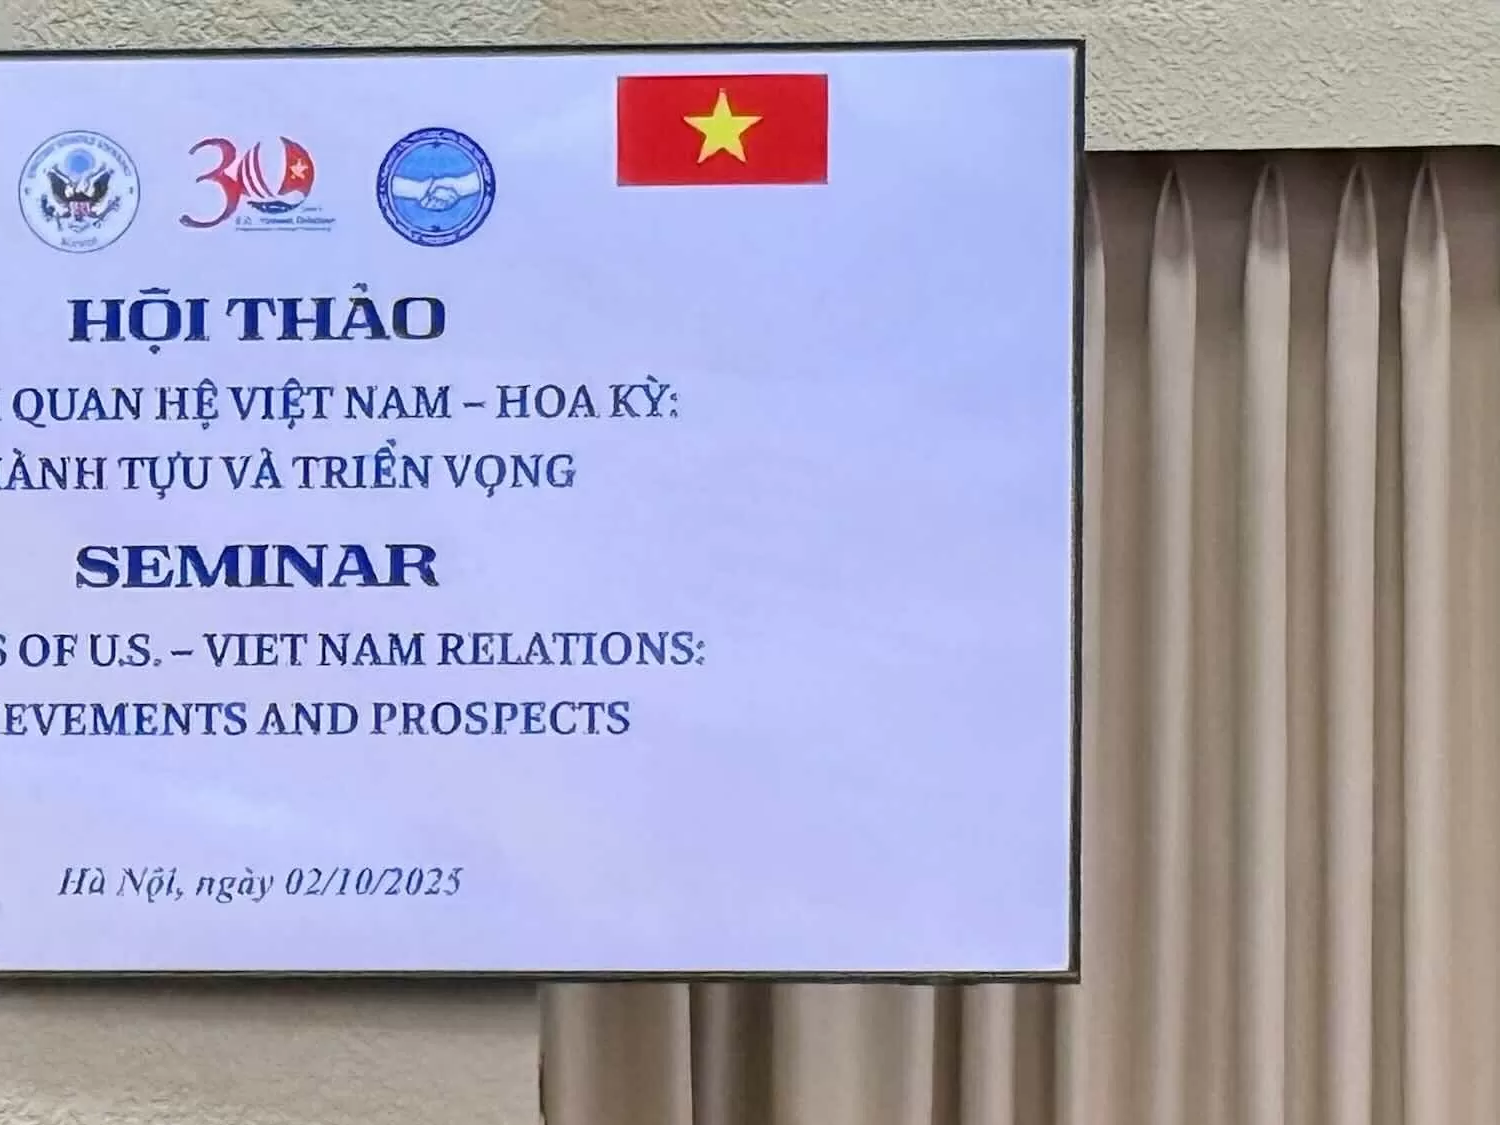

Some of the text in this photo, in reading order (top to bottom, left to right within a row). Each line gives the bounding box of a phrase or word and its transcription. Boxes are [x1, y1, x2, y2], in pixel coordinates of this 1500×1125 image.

[66, 282, 446, 355] HỘI THẢO
[12, 386, 145, 429] QUAN
[154, 377, 220, 431] HỆ
[225, 376, 335, 431] VIỆT
[343, 384, 453, 421] NAM
[495, 383, 601, 420] HOA
[608, 374, 680, 419] KỲ:
[116, 450, 214, 501] TỰU
[219, 446, 285, 491] VÀ
[291, 438, 434, 490] TRIỂN
[441, 453, 577, 499] VỌNG
[75, 543, 441, 589] SEMINAR
[18, 633, 79, 668] OF
[89, 632, 163, 668] U.S.
[201, 632, 309, 668] VIET
[316, 631, 427, 667] NAM
[436, 630, 706, 667] RELATIONS:
[255, 701, 359, 737] AND
[369, 700, 631, 736] PROSPECTS
[57, 866, 464, 904] Hà Nội, ngày 02/10/2025
